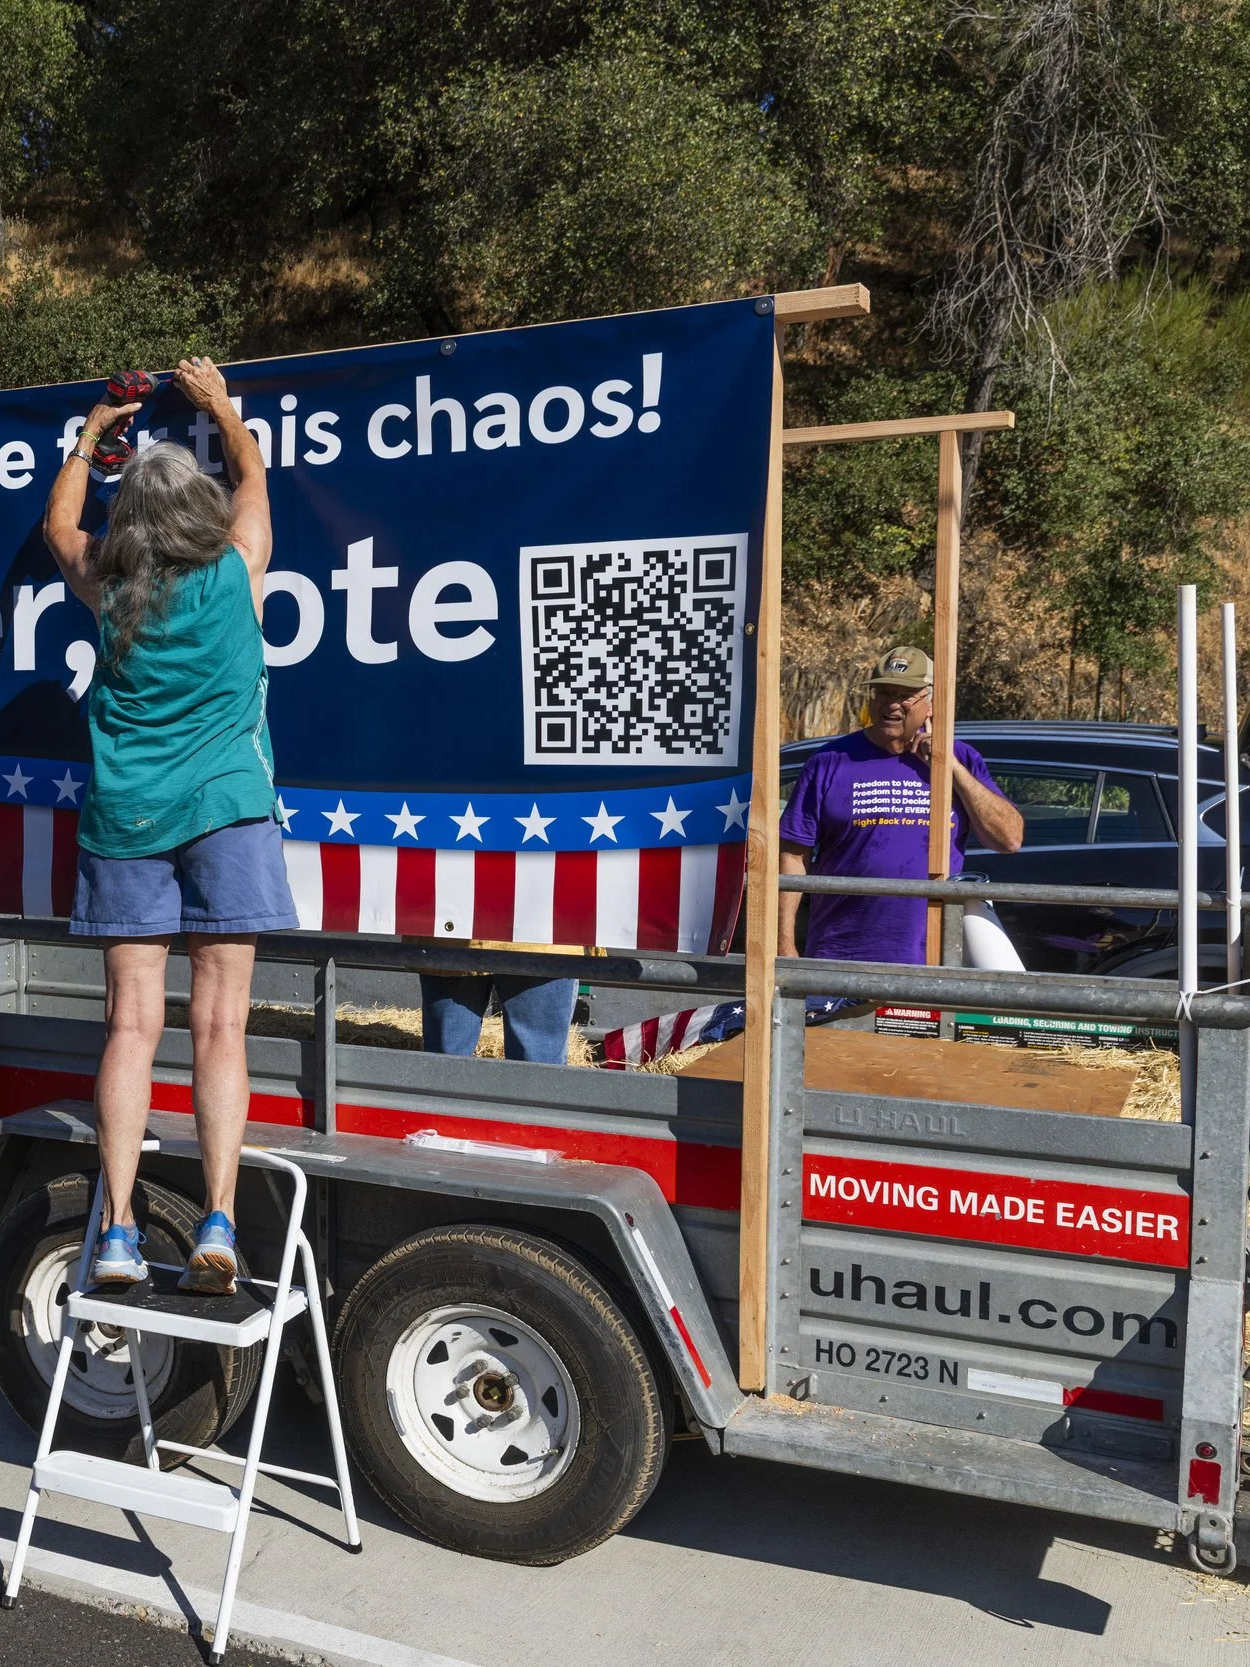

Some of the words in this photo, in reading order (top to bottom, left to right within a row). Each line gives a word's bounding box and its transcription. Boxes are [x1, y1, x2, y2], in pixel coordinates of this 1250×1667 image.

[57, 415, 168, 483] fr
[366, 352, 663, 460] chaos!
[260, 536, 499, 668] ote
[853, 780, 890, 789] Freedom
[902, 780, 922, 788] Vote
[853, 789, 890, 798] Freedom
[853, 797, 890, 806] Freedom
[891, 797, 901, 805] to
[853, 806, 890, 815] Freedom
[853, 819, 877, 828] Fight
[893, 1008, 931, 1019] WARNING
[992, 1016, 1032, 1028] LOADING,
[1033, 1019, 1076, 1030] SECURING
[1077, 1022, 1096, 1032] AND
[1098, 1024, 1133, 1034] TOWING
[834, 1103, 967, 1137] U-HAUL
[810, 1173, 940, 1211] MOVING
[949, 1190, 1045, 1225] MADE
[1056, 1202, 1180, 1242] EASIER
[810, 1263, 1178, 1349] uhaul.com
[816, 1338, 856, 1369] HO
[864, 1347, 930, 1381] 2723
[938, 1359, 960, 1387] N
